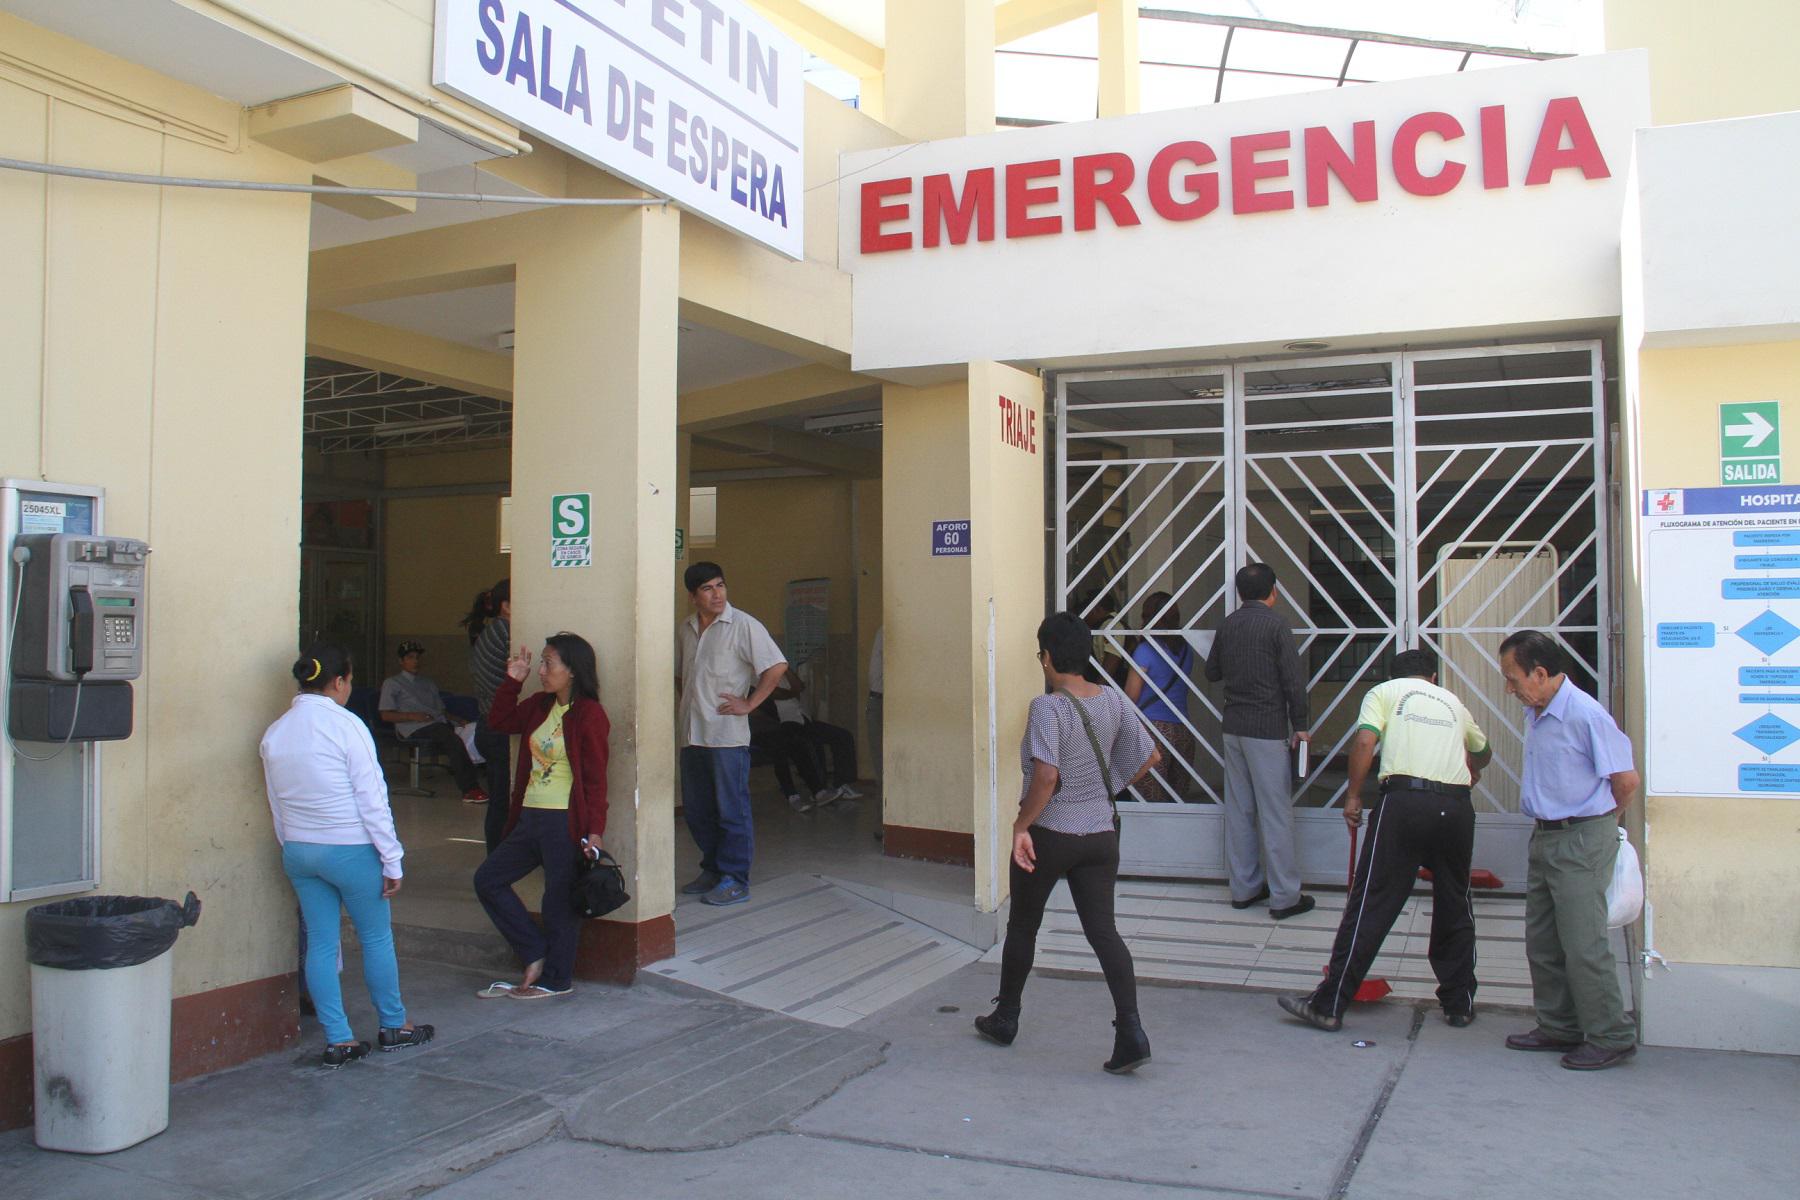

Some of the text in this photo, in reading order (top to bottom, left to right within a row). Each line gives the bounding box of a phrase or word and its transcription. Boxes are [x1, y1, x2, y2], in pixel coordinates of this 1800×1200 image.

[613, 0, 779, 109] ETIN
[476, 0, 788, 229] SALA DE ESPERA
[861, 96, 1611, 254] EMERGENCIA
[999, 395, 1036, 454] TRIAJE
[1724, 464, 1777, 481] SALIDA
[23, 504, 62, 515] 25045XL
[558, 498, 584, 535] S
[1757, 518, 1787, 526] PACIENTE
[936, 523, 968, 531] AFORO
[944, 532, 960, 545] 60
